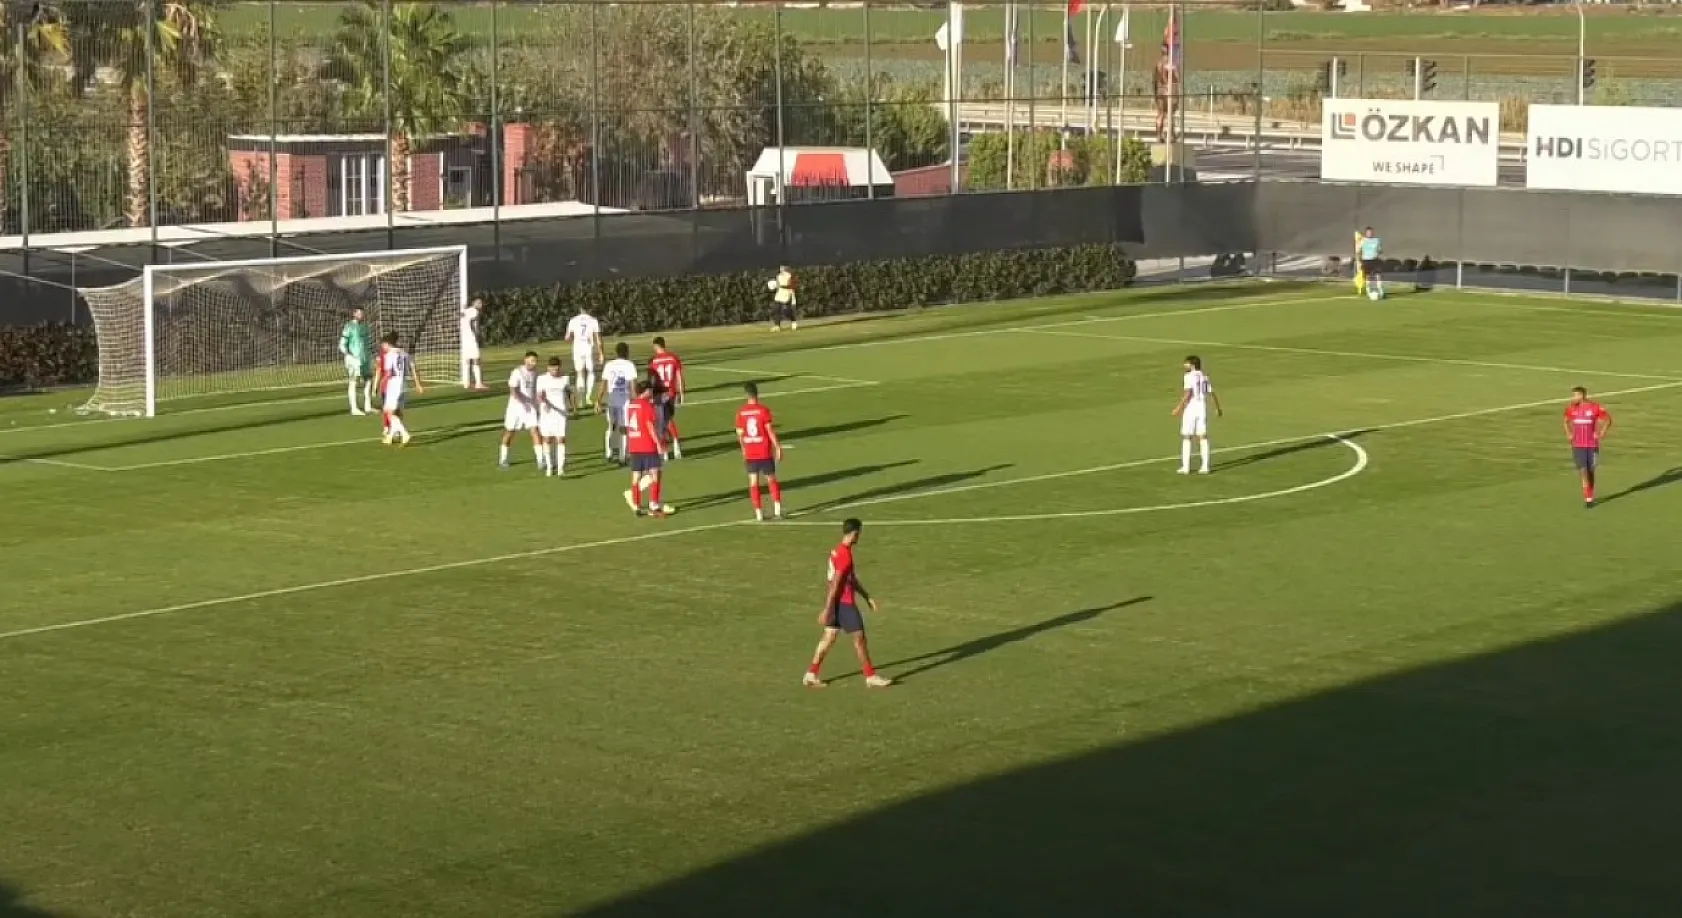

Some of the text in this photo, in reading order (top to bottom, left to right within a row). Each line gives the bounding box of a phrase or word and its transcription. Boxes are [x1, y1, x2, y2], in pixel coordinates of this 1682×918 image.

[1361, 107, 1489, 144] ÖZKAN
[1535, 136, 1583, 159] HDI
[1372, 161, 1435, 175] WE SHAPE
[656, 364, 674, 382] 11
[629, 410, 639, 431] 4
[746, 417, 758, 437] 6
